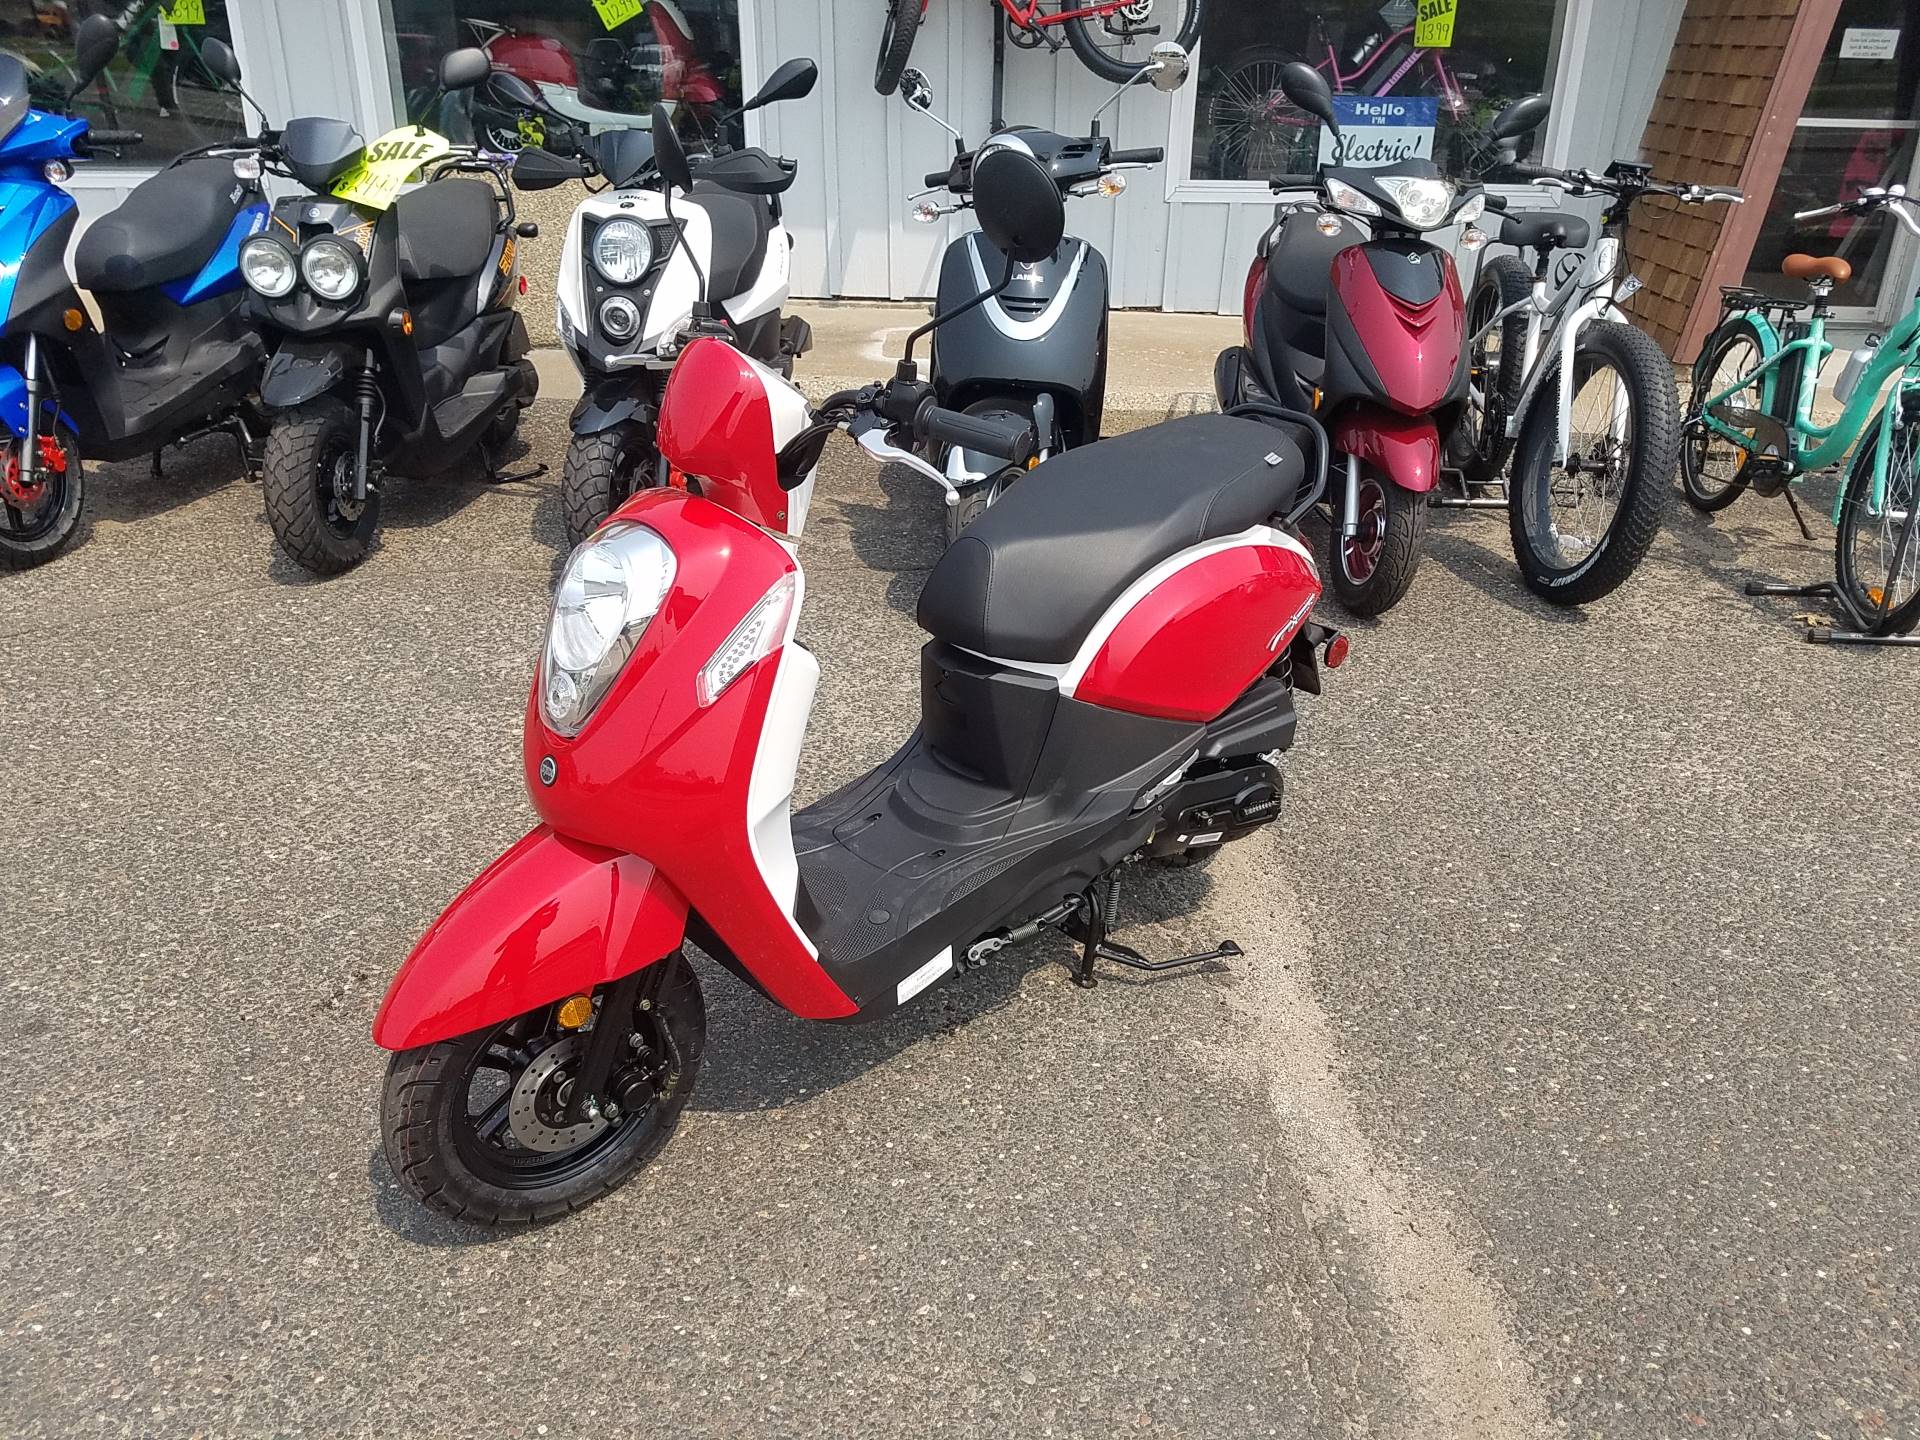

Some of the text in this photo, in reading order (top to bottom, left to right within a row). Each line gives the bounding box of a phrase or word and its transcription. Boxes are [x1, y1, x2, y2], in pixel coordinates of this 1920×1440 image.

[1420, 0, 1453, 22] SALE
[1355, 103, 1405, 116] Hello
[1371, 117, 1386, 125] I'M
[367, 141, 434, 163] SALE
[1331, 134, 1423, 162] Electric!
[1545, 357, 1562, 382] KEND
